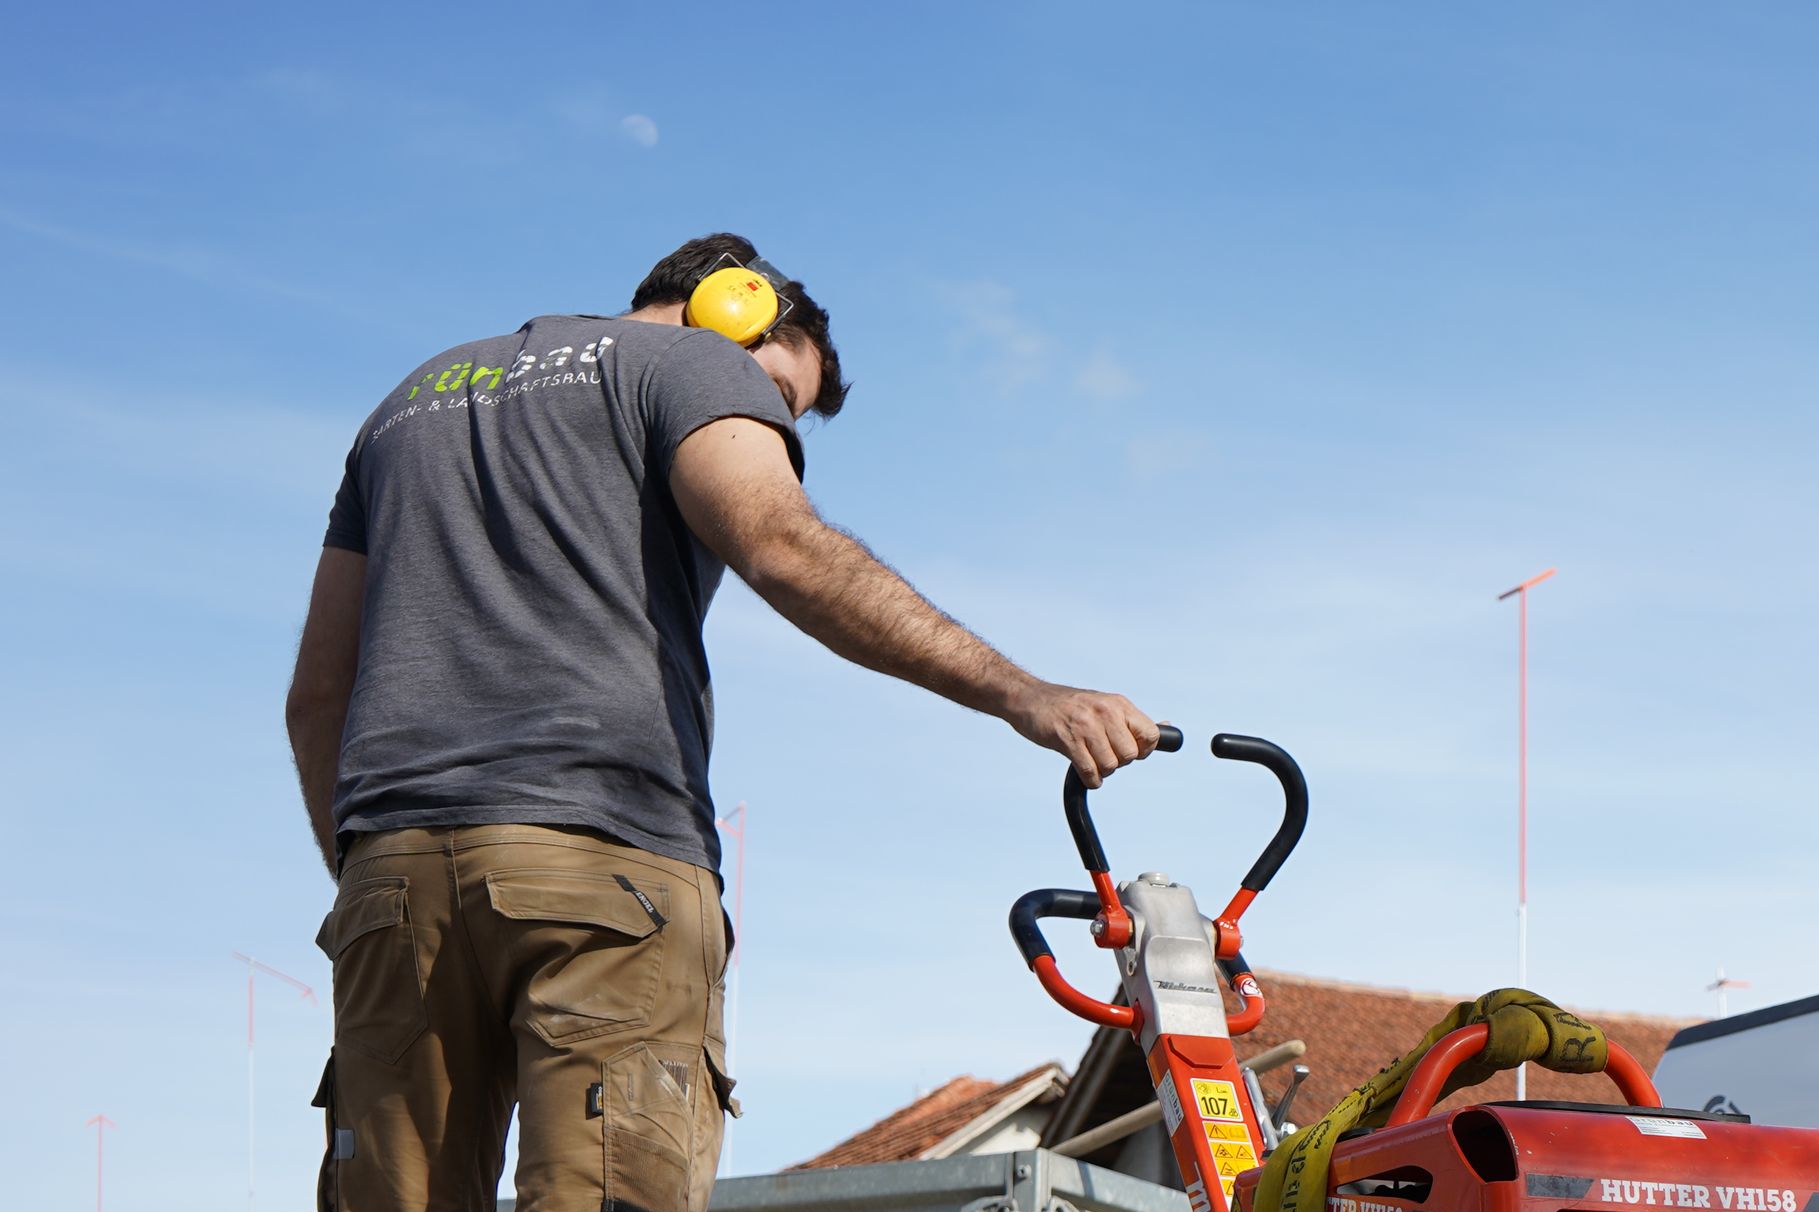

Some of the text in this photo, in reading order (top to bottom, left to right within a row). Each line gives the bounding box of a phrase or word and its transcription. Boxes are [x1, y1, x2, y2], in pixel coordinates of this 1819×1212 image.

[428, 401, 440, 411] &
[1201, 1096, 1228, 1116] 107
[1600, 1178, 1798, 1212] HUTTER VH158
